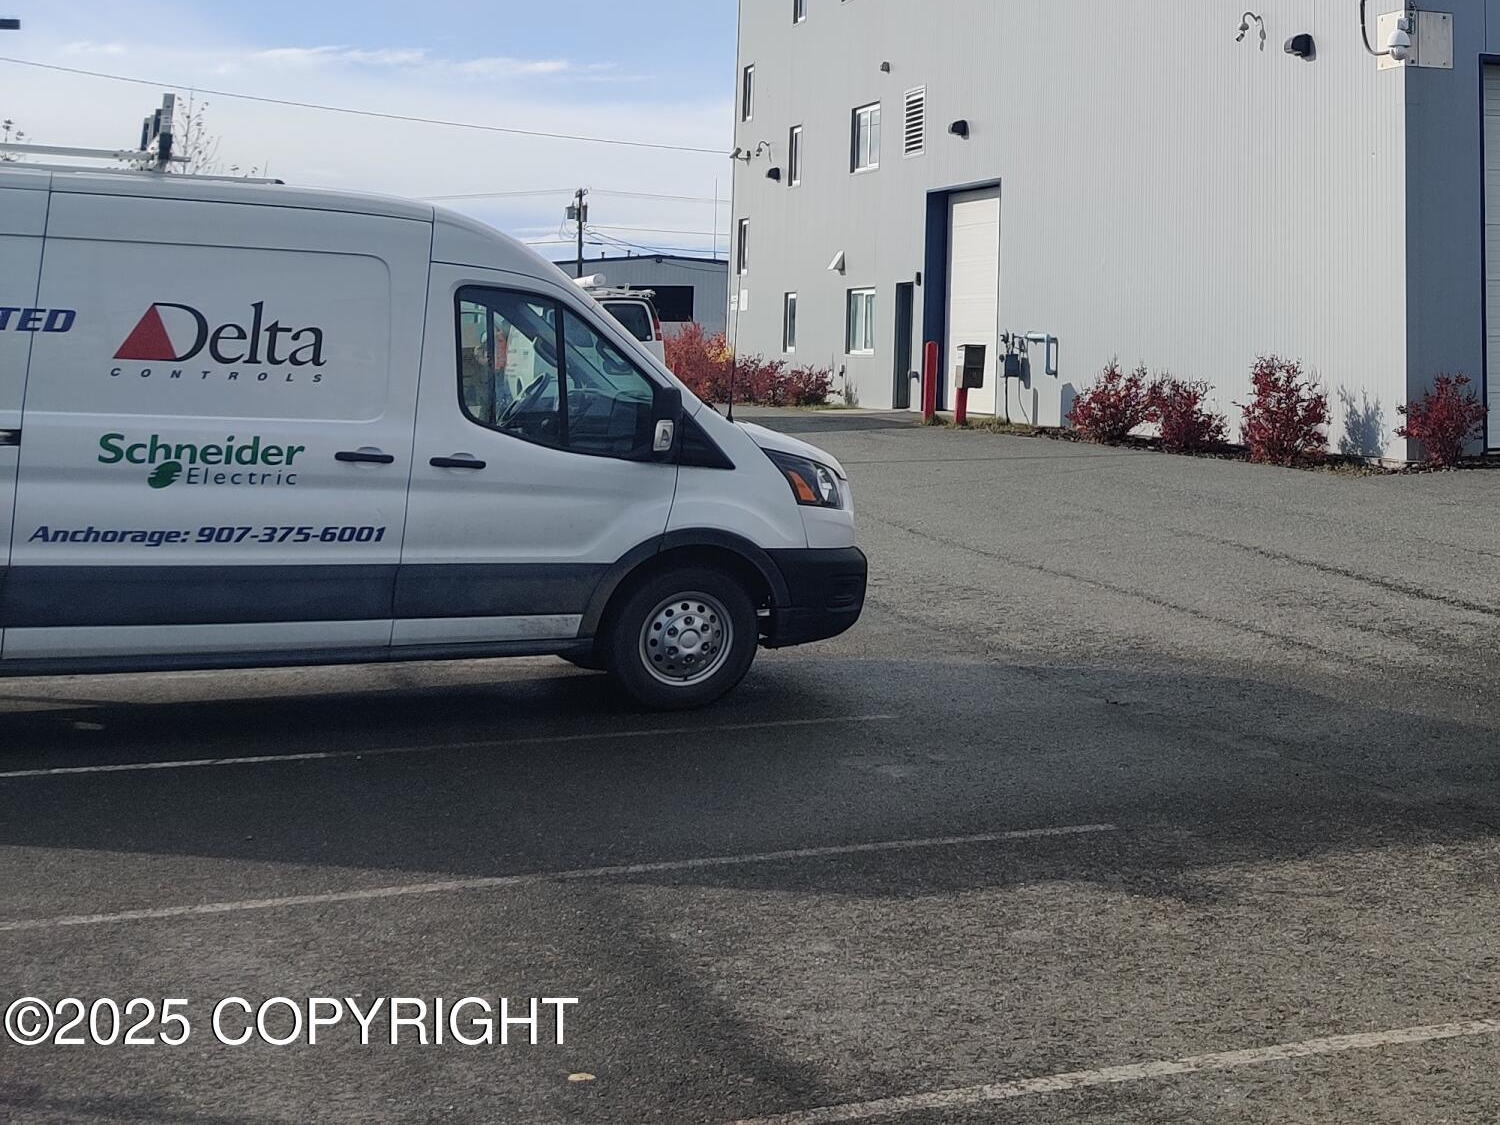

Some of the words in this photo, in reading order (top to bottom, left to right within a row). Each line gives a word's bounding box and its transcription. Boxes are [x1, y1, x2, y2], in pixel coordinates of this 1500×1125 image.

[146, 301, 327, 367] Delta
[110, 367, 322, 383] CONTROLS
[98, 433, 305, 466] Schneider
[186, 467, 297, 486] Electric
[28, 526, 190, 547] Anchorage:
[196, 526, 386, 543] 907-375-6001
